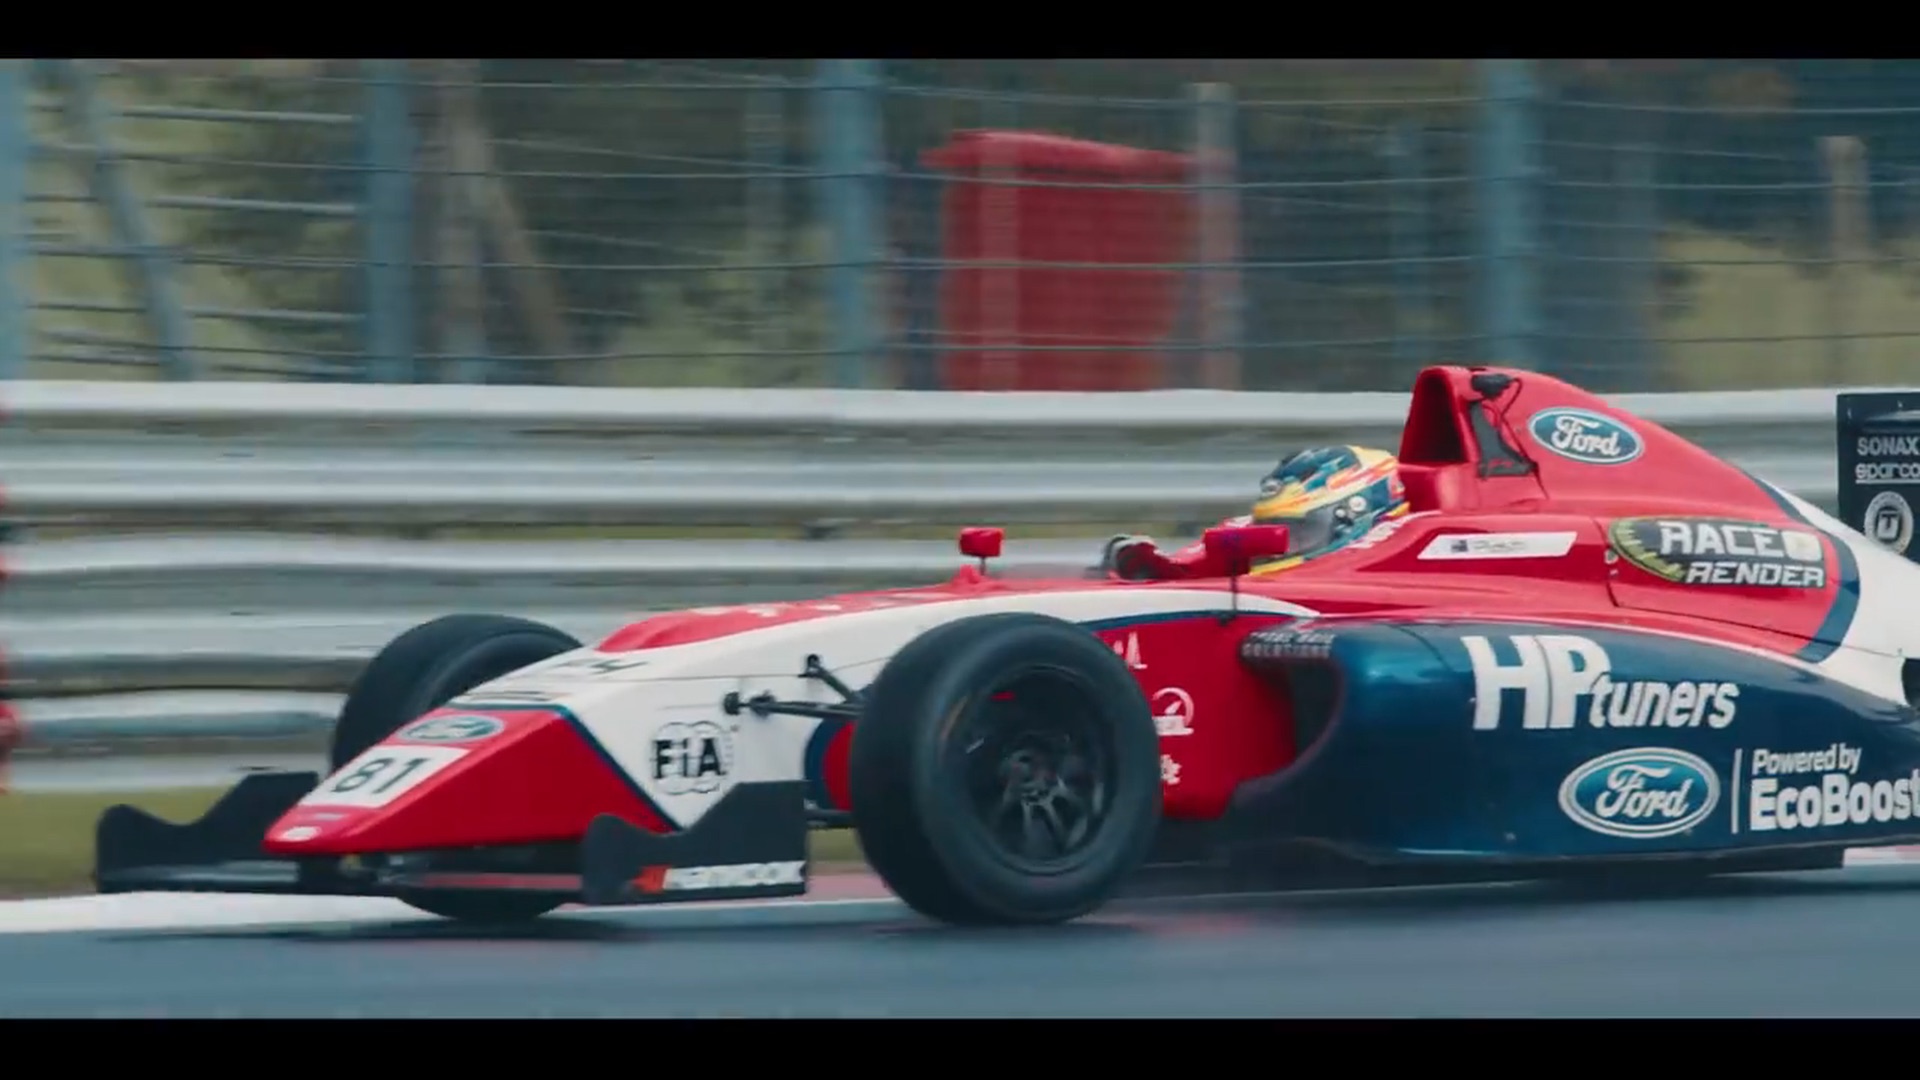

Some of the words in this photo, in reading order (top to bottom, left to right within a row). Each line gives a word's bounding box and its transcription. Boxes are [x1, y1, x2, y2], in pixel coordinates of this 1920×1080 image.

[1551, 414, 1621, 457] Ford
[1857, 436, 1920, 457] SONAX
[1855, 462, 1920, 481] sparco
[1656, 520, 1784, 558] RACE
[1686, 562, 1824, 588] RENDER
[331, 757, 430, 794] 81
[1752, 743, 1838, 776] Powered
[1839, 743, 1862, 775] by
[1595, 763, 1696, 820] Ford
[1750, 768, 1920, 831] EcoBoost
